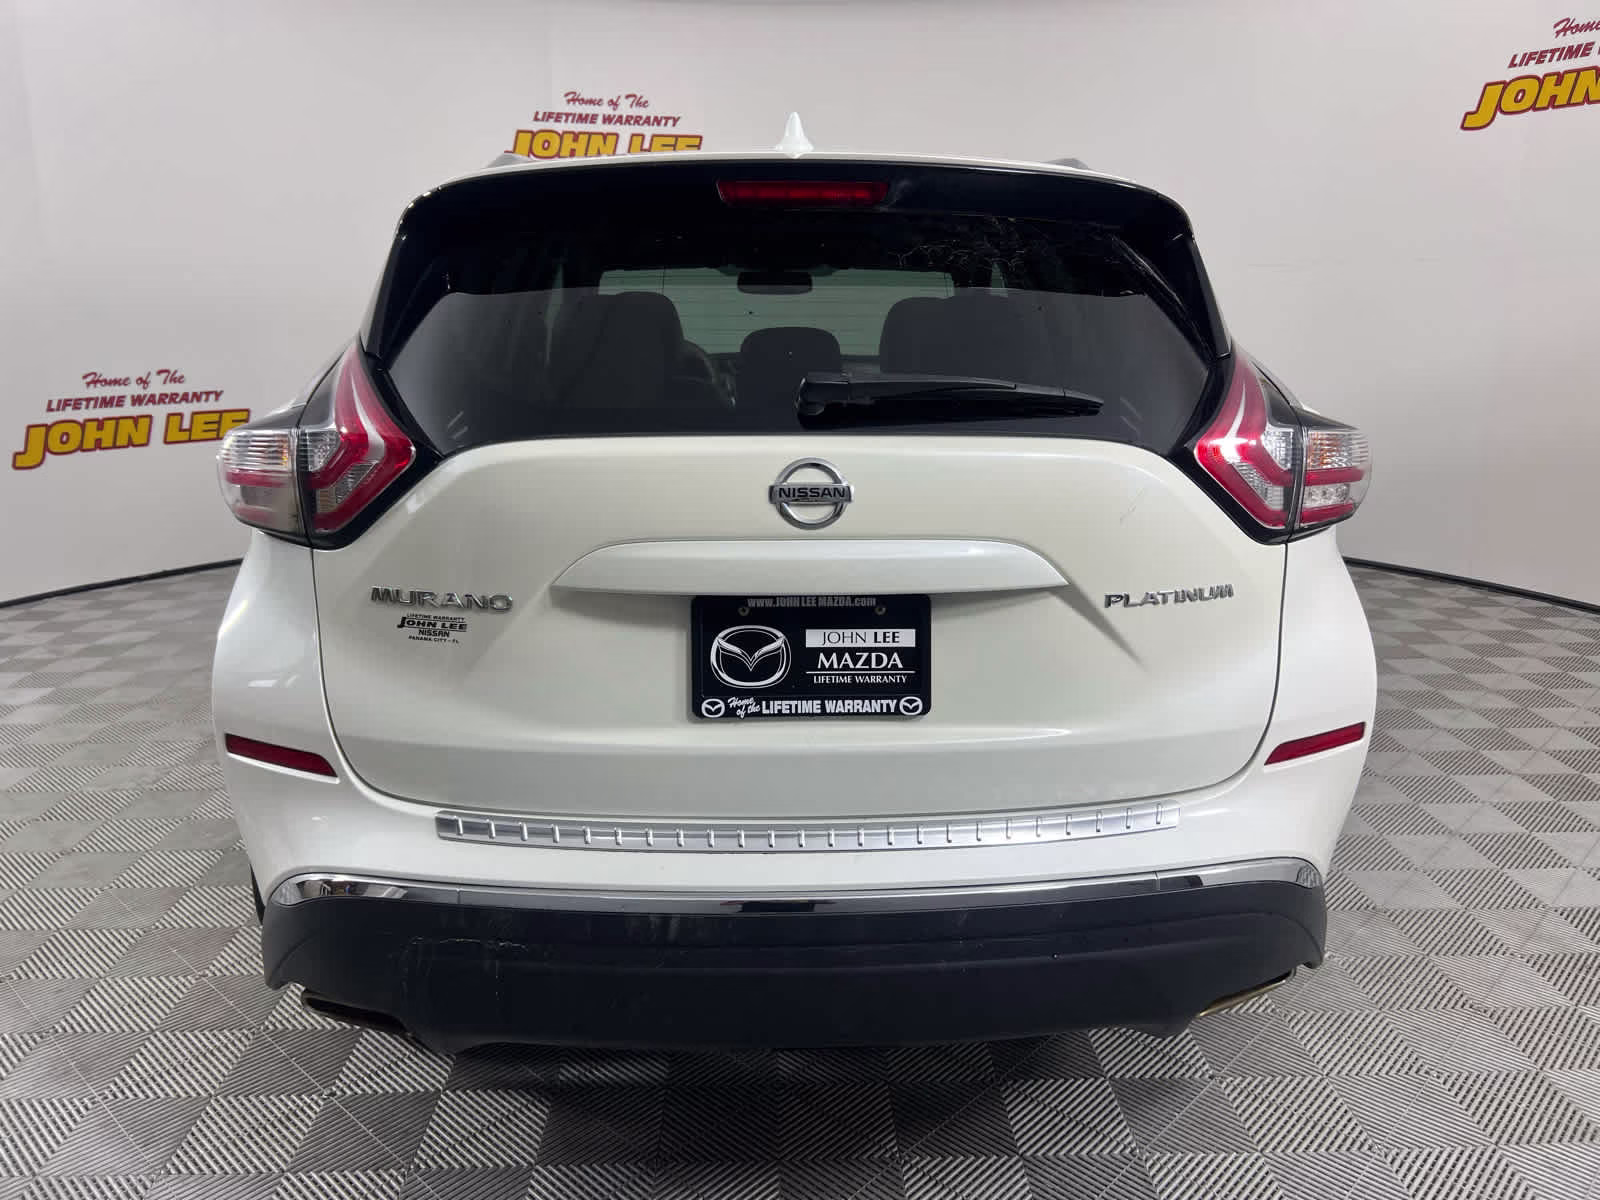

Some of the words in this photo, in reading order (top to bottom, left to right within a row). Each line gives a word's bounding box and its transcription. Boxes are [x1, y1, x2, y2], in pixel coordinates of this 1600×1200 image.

[1553, 17, 1600, 39] Home
[1508, 41, 1595, 68] LIFETIME
[564, 91, 604, 107] Home
[607, 95, 621, 111] of
[625, 93, 649, 108] The
[1460, 65, 1600, 131] JOHN
[533, 111, 599, 125] LIFETIME
[602, 113, 681, 127] WARRANTY
[503, 129, 620, 159] JOHN
[82, 372, 130, 389] Home
[135, 372, 151, 390] of
[156, 369, 185, 385] The
[46, 395, 127, 413] LIFETIME
[130, 390, 224, 407] WARRANTY
[11, 414, 153, 471] JOHN
[778, 487, 846, 499] NISSAN
[370, 585, 514, 612] MURANO
[1104, 583, 1235, 608] PLATINUM
[397, 616, 437, 629] JOHN
[440, 622, 468, 630] LEE
[418, 629, 450, 637] NISSAN
[821, 631, 867, 646] JOHN
[873, 631, 900, 644] LEE
[817, 652, 904, 669] MAZDA
[813, 676, 852, 684] LIFETIME
[854, 675, 907, 684] WARRANTY
[727, 697, 754, 709] Home
[736, 705, 746, 719] of
[747, 702, 760, 714] the
[762, 700, 821, 714] LIFETIME
[824, 699, 897, 714] WARRANTY
